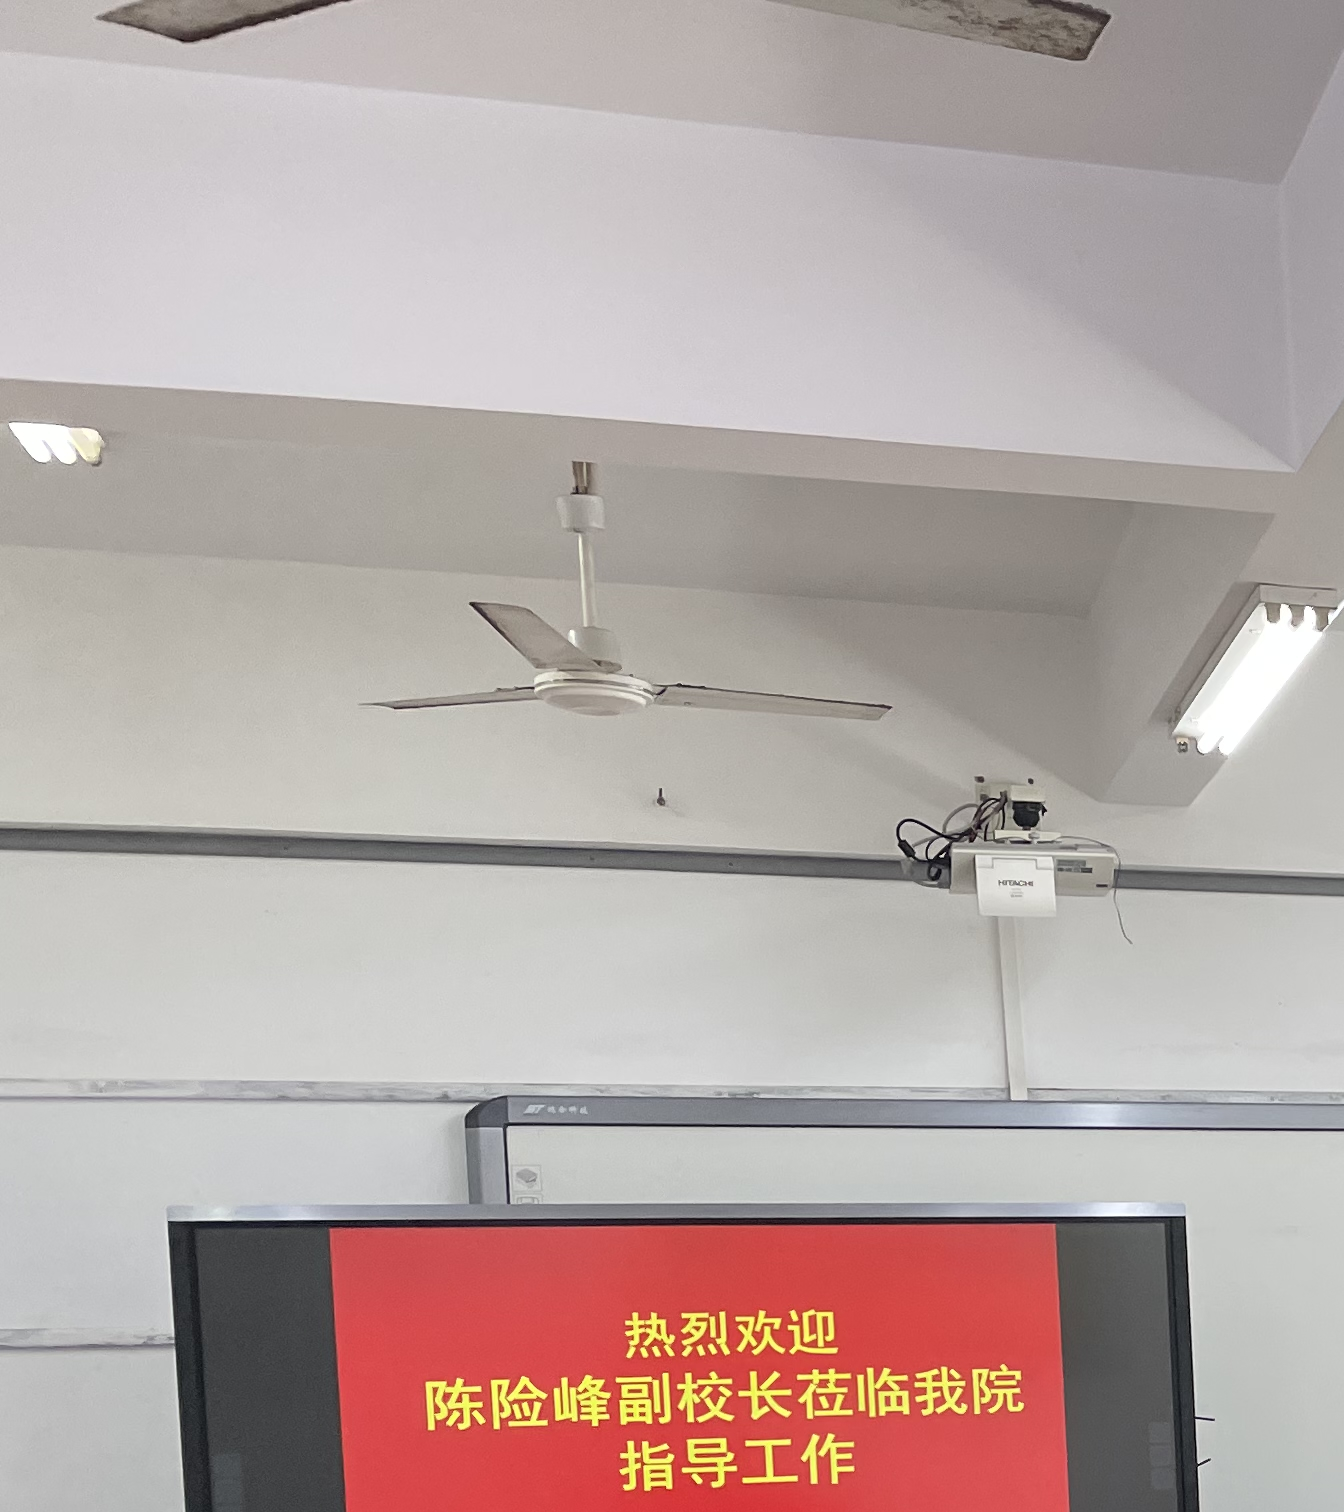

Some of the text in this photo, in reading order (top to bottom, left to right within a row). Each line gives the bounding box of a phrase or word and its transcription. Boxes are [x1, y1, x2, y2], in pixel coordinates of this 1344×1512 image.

[998, 879, 1034, 887] HITACHI
[624, 1308, 839, 1359] 热烈欢迎
[423, 1363, 1025, 1432] 陈险峰副校长莅临我院
[618, 1432, 857, 1492] 指导工作
